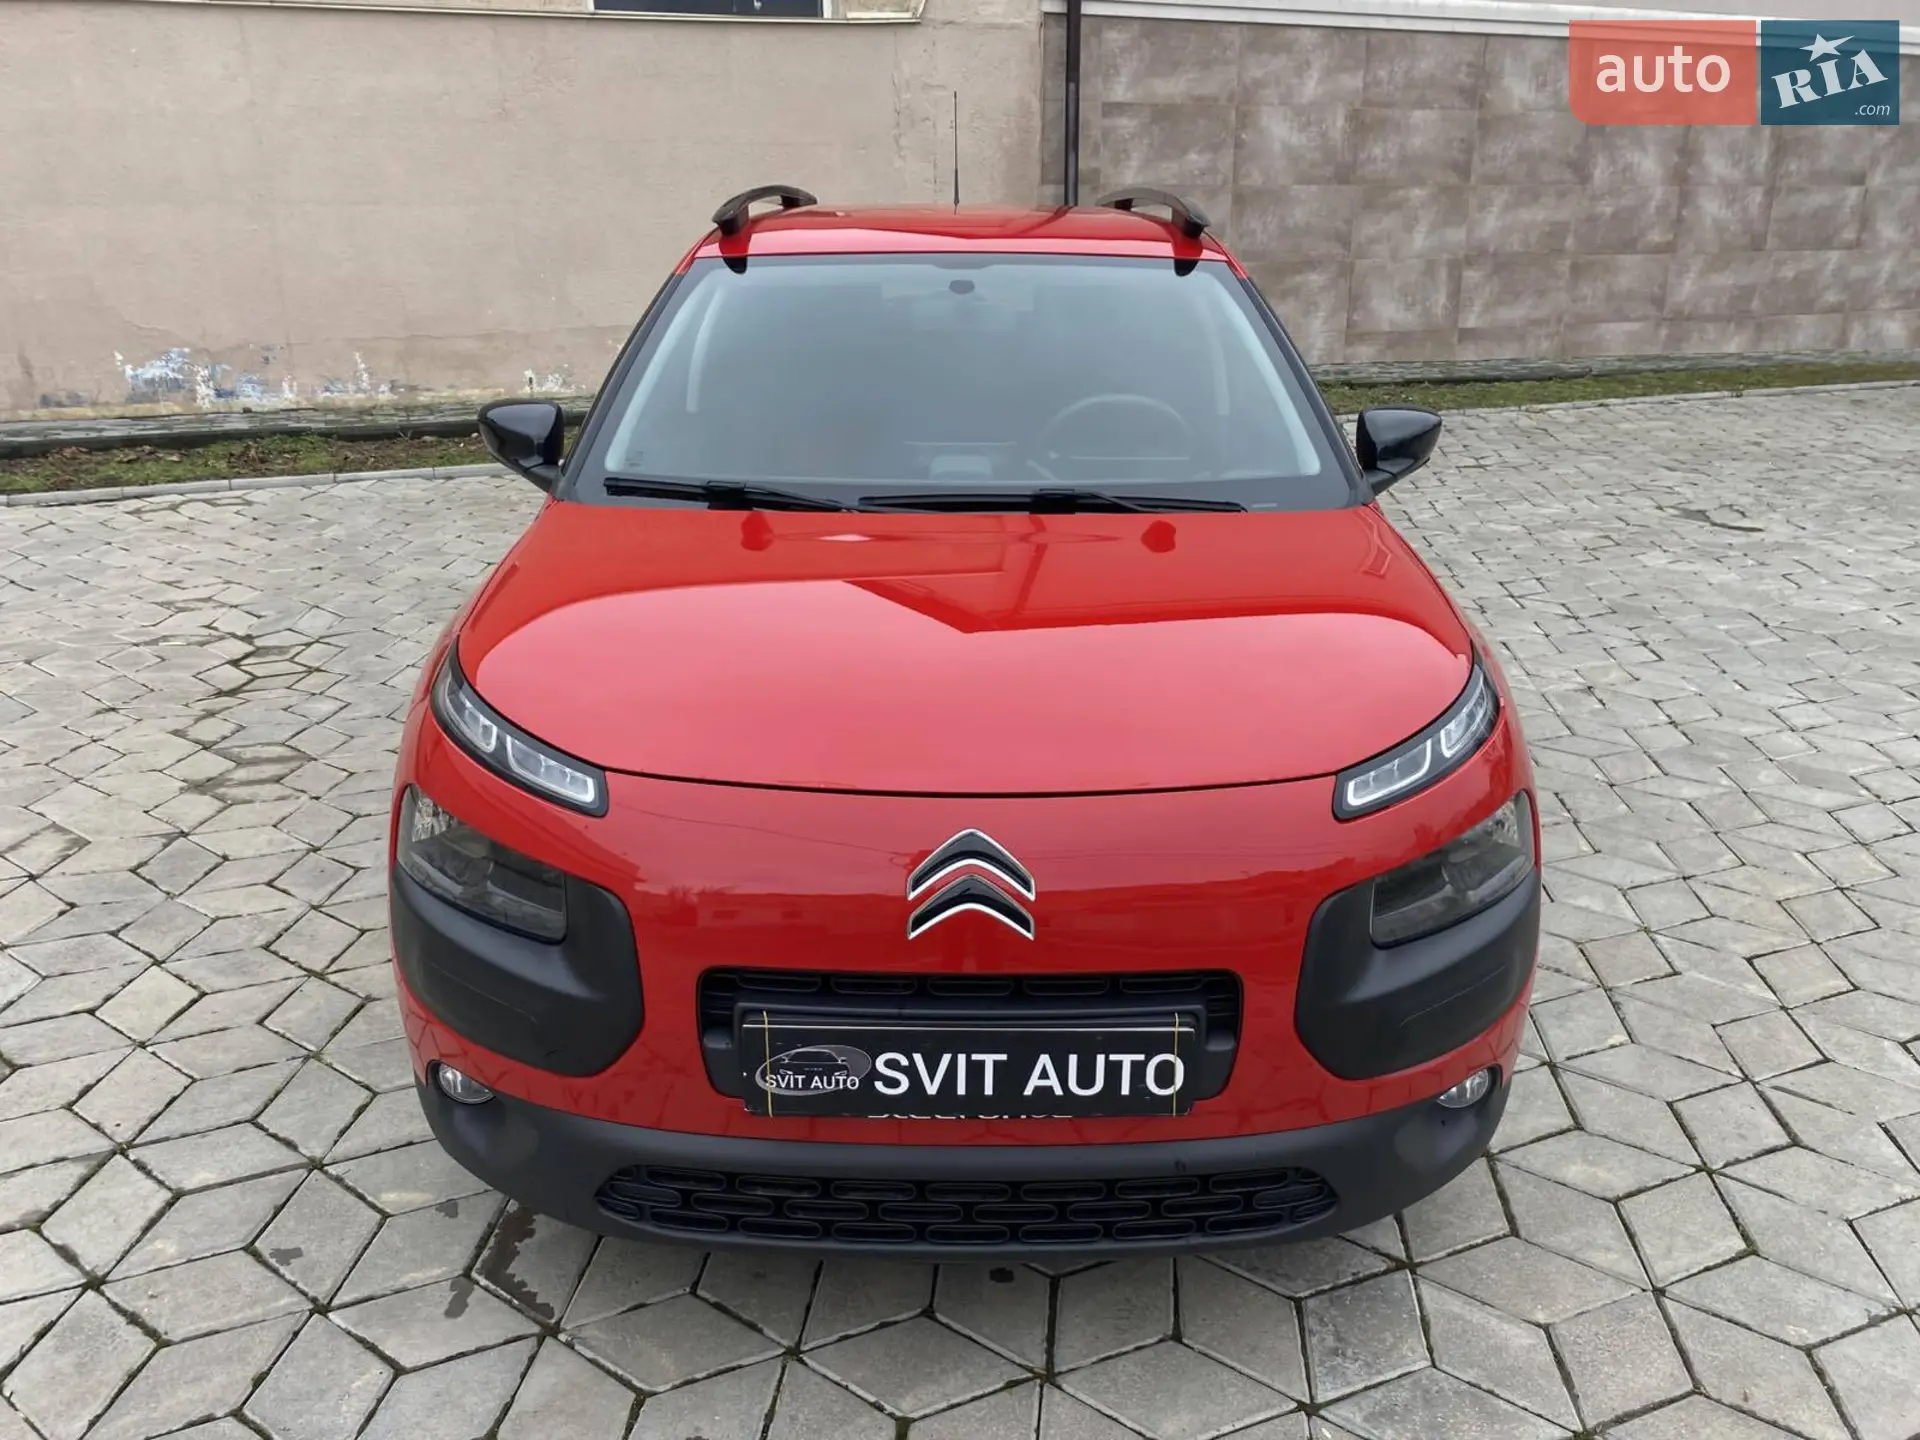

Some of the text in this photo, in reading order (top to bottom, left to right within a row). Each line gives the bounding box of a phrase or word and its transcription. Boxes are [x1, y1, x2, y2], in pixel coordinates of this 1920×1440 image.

[765, 1074, 860, 1090] SVIT AUTO
[874, 1052, 1185, 1097] SVIT AUTO
